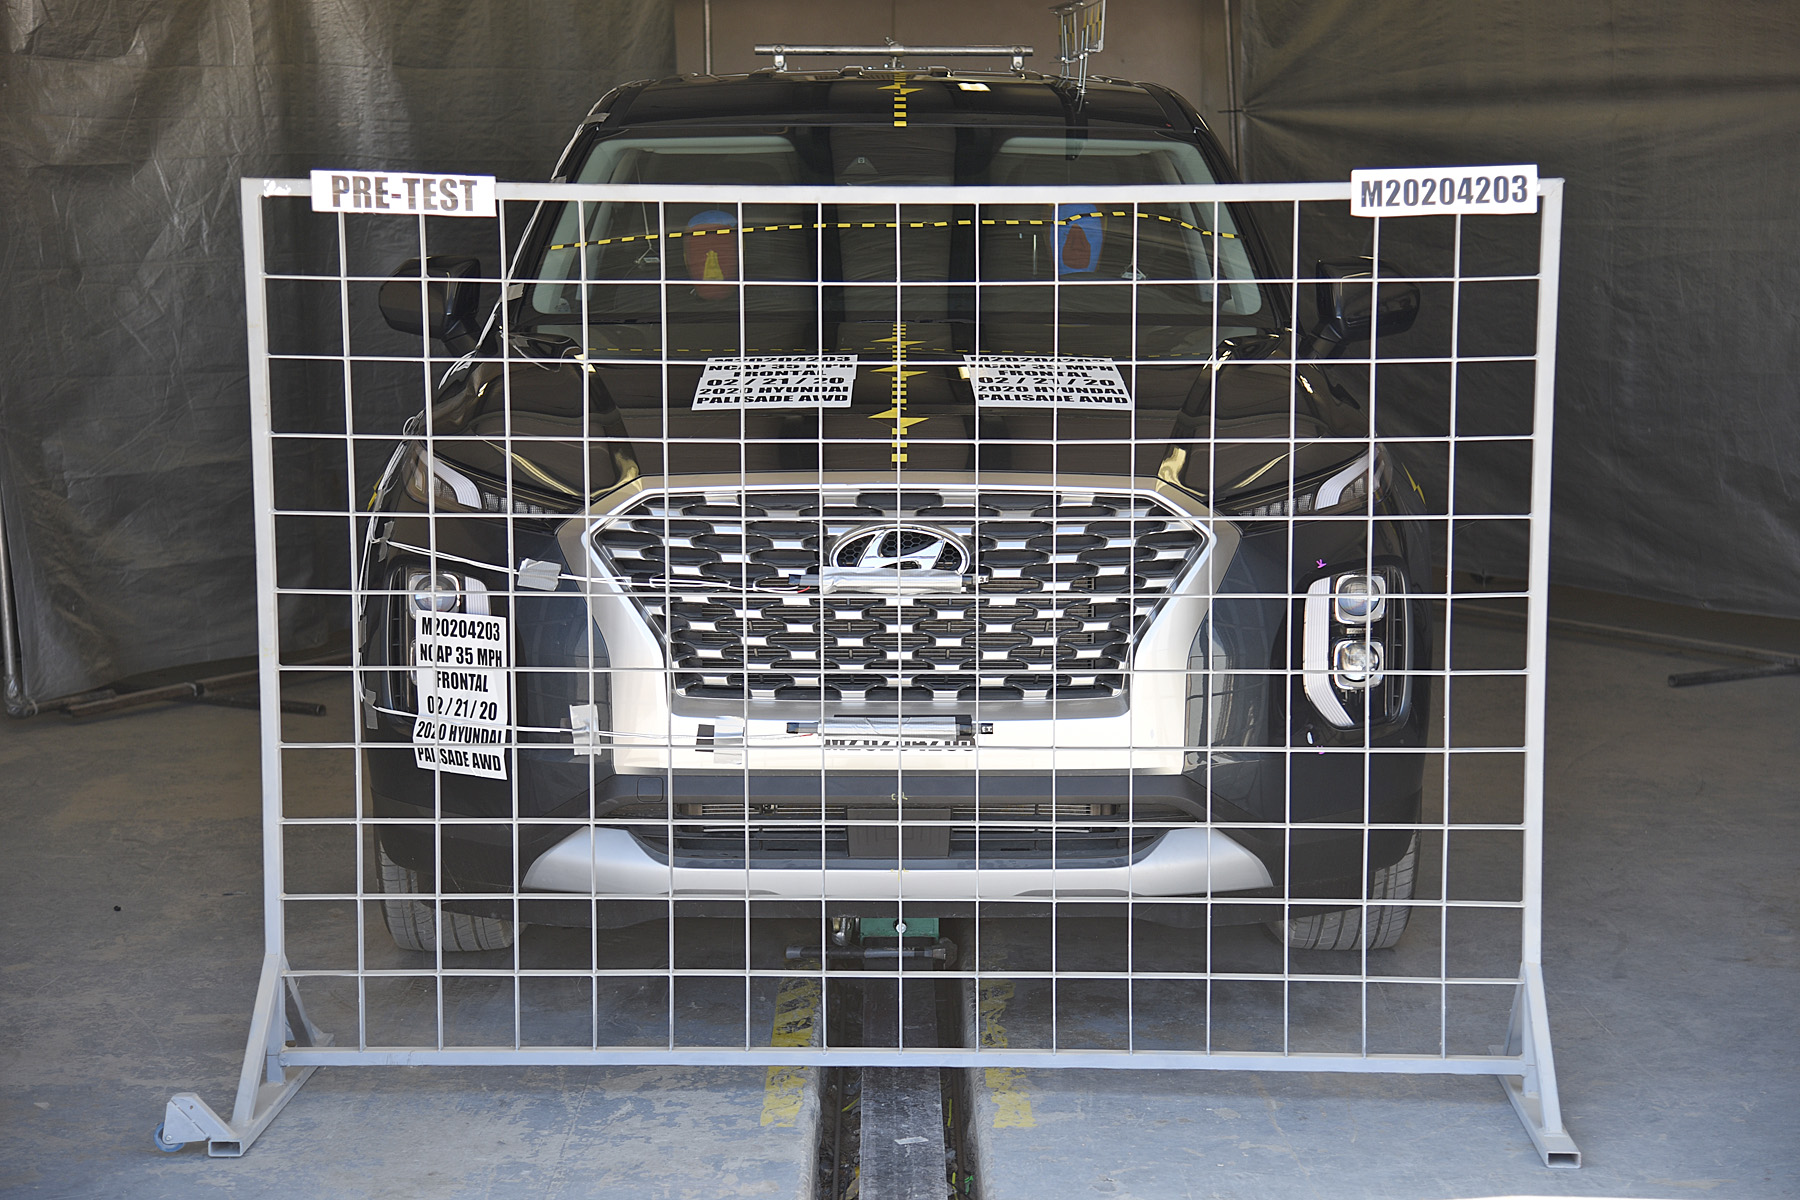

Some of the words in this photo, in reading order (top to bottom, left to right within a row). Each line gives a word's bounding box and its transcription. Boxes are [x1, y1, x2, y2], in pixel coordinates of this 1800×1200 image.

[331, 174, 478, 212] PRE-TEST
[1361, 174, 1528, 208] M20204203
[998, 370, 1092, 378] FRONTAL
[696, 395, 794, 404] PALISADE
[798, 394, 848, 402] AWD
[699, 387, 753, 395] 2020
[758, 386, 849, 394] HYUNDAI
[976, 385, 1029, 393] 2020
[1034, 386, 1125, 395] HYUNDAI
[978, 394, 1075, 403] PALISADE
[1079, 395, 1129, 404] AWD
[421, 616, 500, 642] M20204203
[455, 646, 474, 665] 35
[477, 647, 503, 668] MPH
[436, 670, 489, 693] FRONTAL
[479, 700, 498, 721] 20
[448, 724, 503, 744] HYUNDAI
[417, 747, 470, 768] PASADE
[472, 752, 501, 772] AWD
